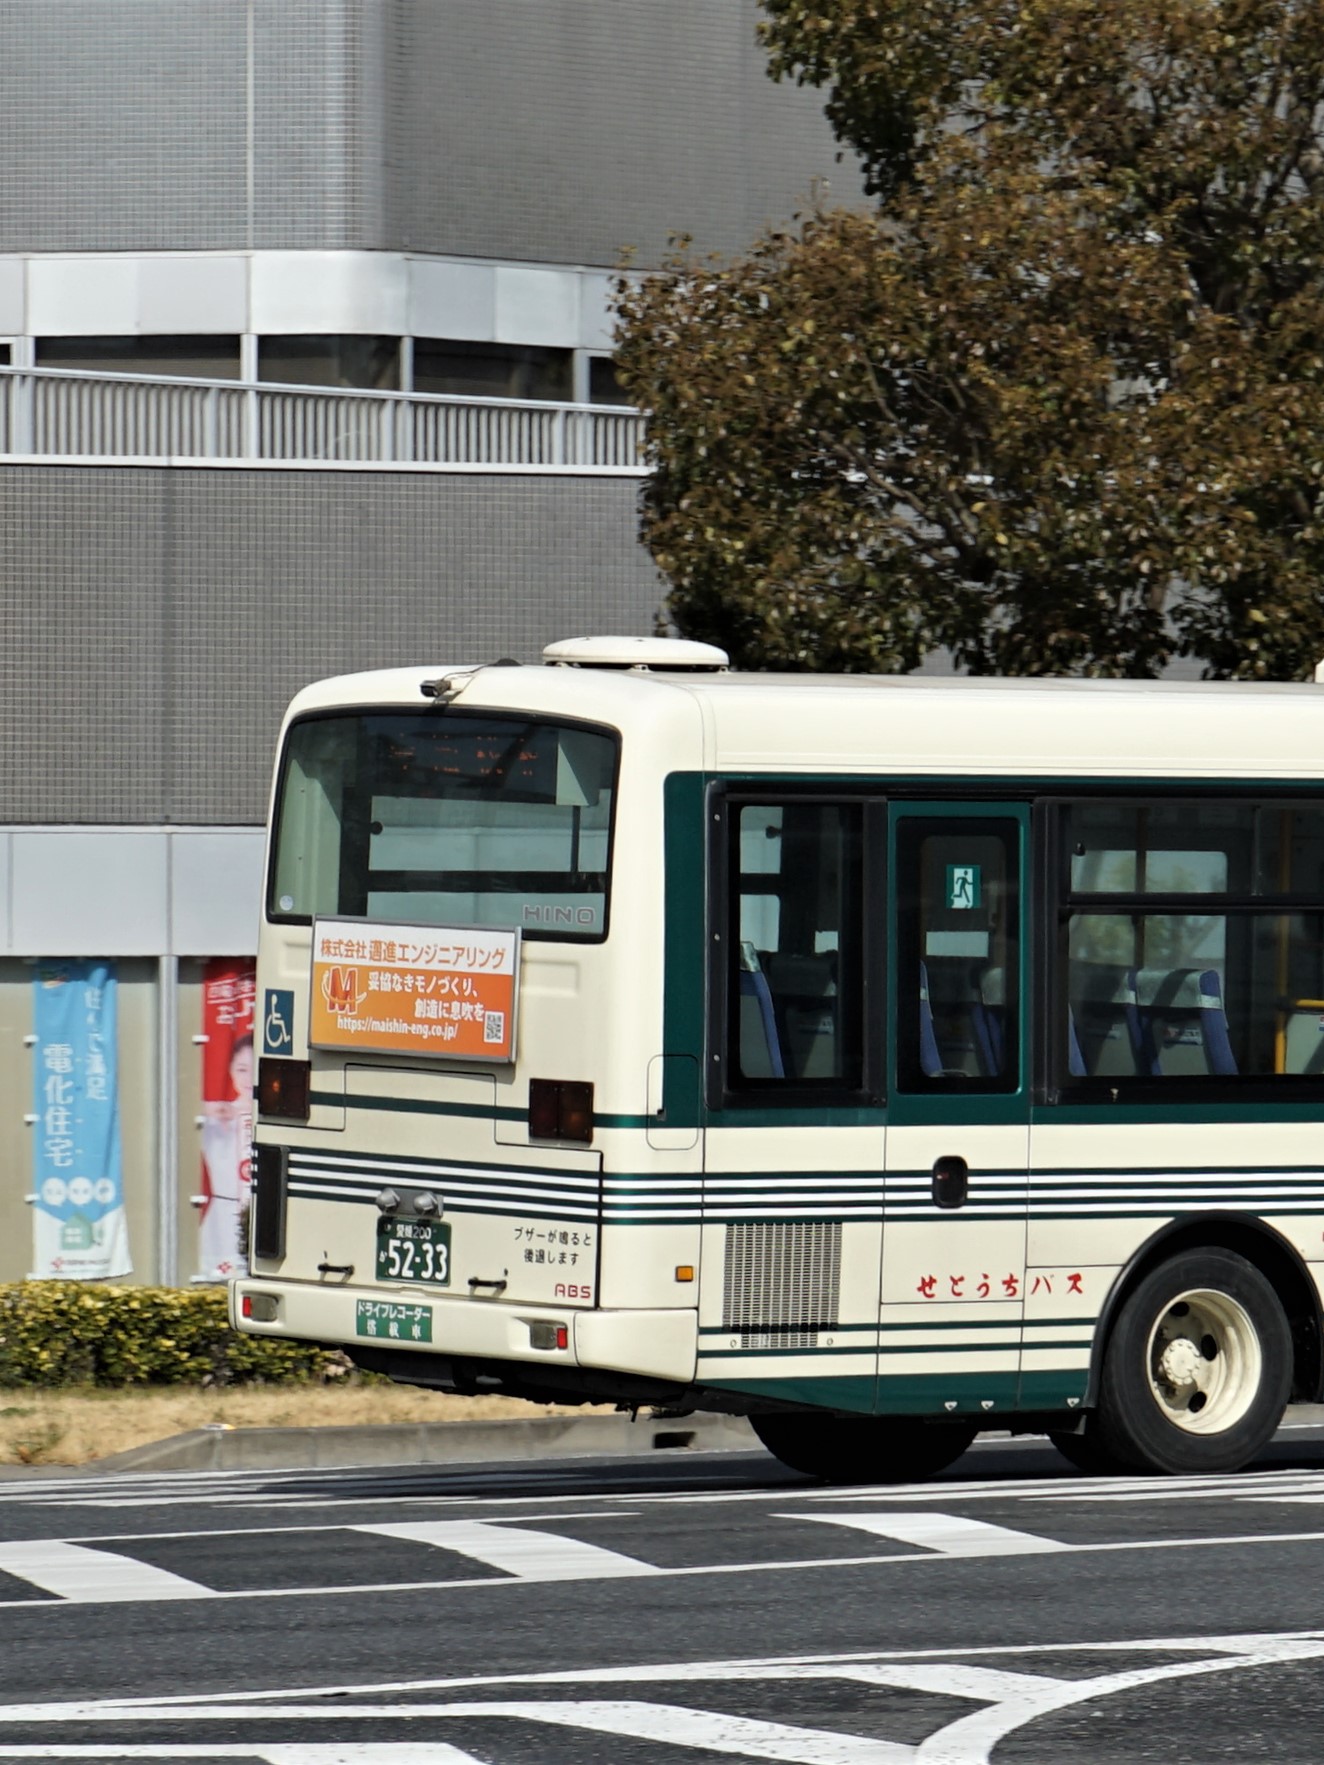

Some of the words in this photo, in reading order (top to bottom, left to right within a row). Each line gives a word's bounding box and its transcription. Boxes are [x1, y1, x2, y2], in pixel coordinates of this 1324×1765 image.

[523, 904, 596, 925] HINO
[414, 998, 484, 1022] 創造に息吹を
[337, 1015, 459, 1041] https://maishin-eng.co.jp/
[43, 1043, 75, 1167] 電化住宅
[514, 1227, 591, 1246] ブザーが鳴ると
[388, 1239, 448, 1280] 52-33
[523, 1248, 579, 1266] 後退します
[555, 1283, 591, 1299] ABS
[916, 1271, 1084, 1299] せとうちバス
[358, 1301, 430, 1321] ドライブレコーダー
